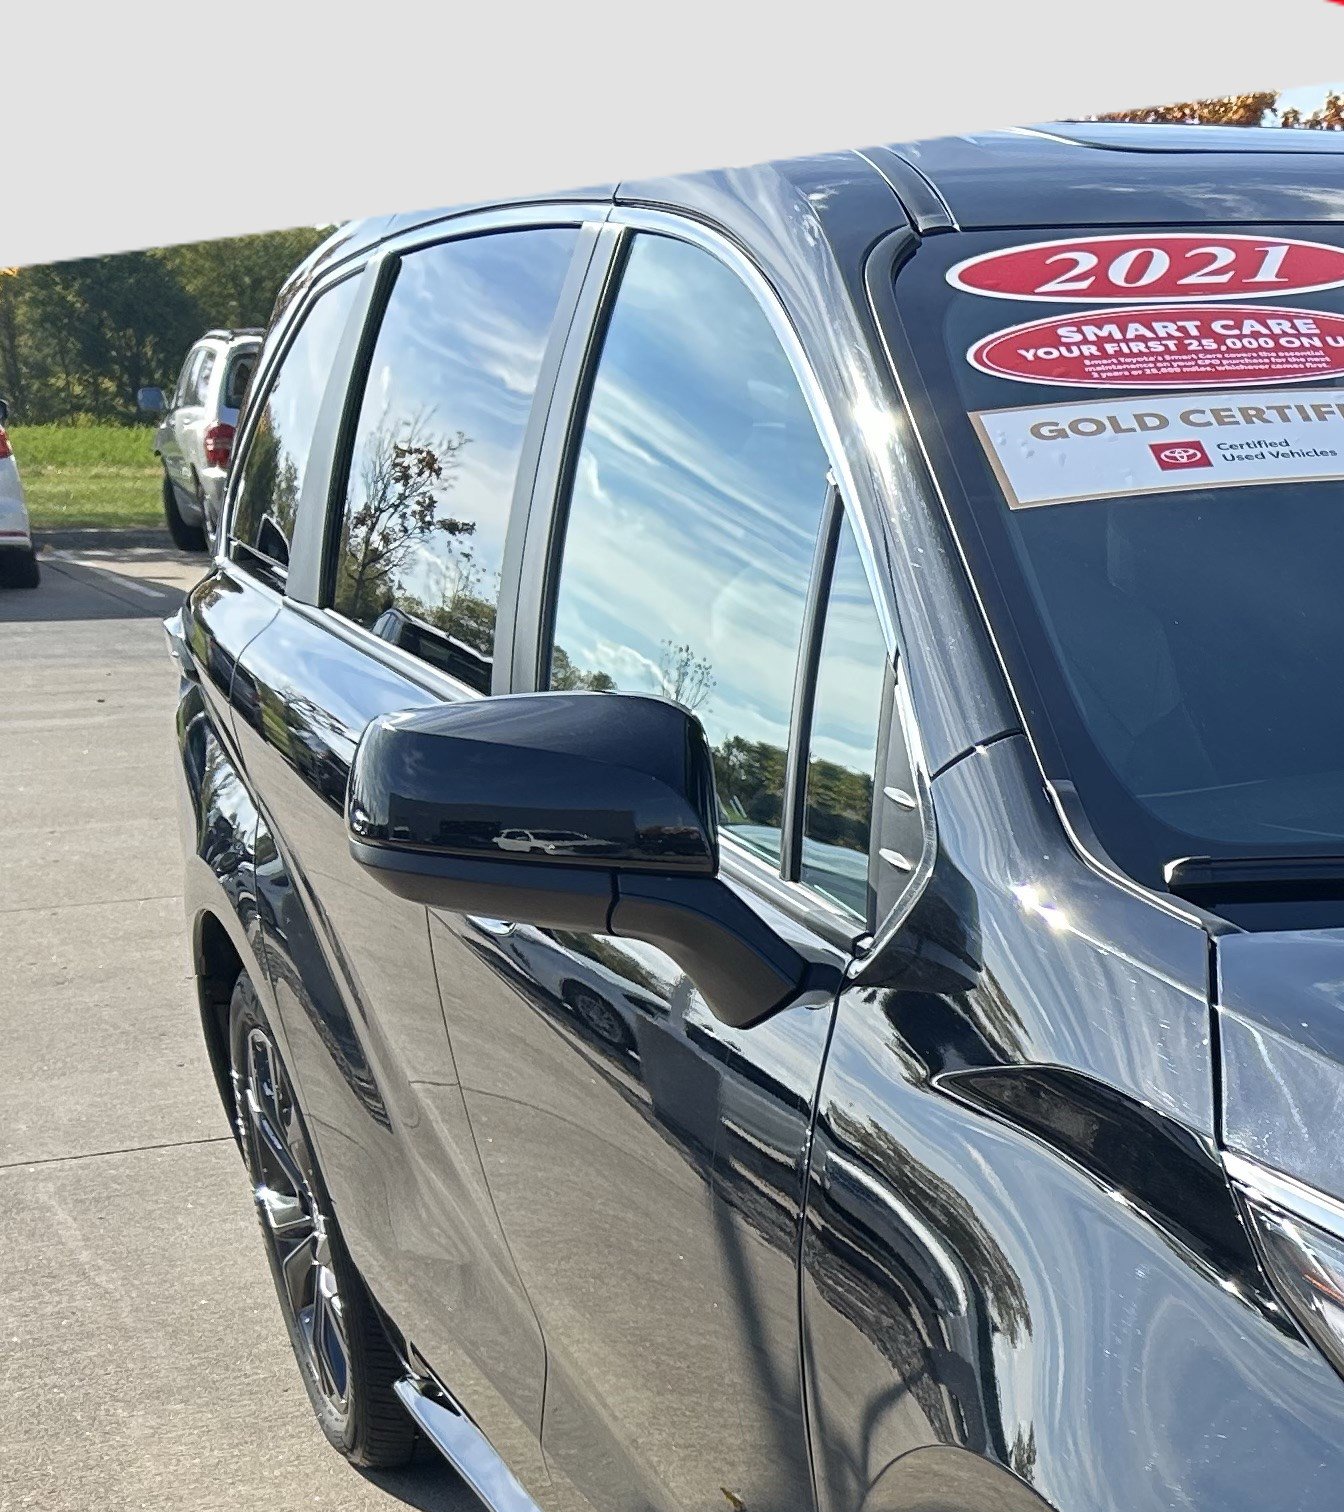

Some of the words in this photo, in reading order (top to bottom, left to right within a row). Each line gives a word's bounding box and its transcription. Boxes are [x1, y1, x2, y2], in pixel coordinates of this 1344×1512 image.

[1034, 245, 1291, 293] 2021
[1056, 320, 1202, 343] SMART
[1211, 318, 1321, 336] CARE
[1017, 344, 1101, 361] YOUR
[1103, 340, 1179, 355] FIRST
[1183, 336, 1275, 352] 25,000
[1278, 336, 1324, 349] ON
[1029, 411, 1170, 441] GOLD
[1216, 438, 1291, 451] Certified
[1221, 451, 1266, 462] Used
[1267, 448, 1338, 460] Vehicles
